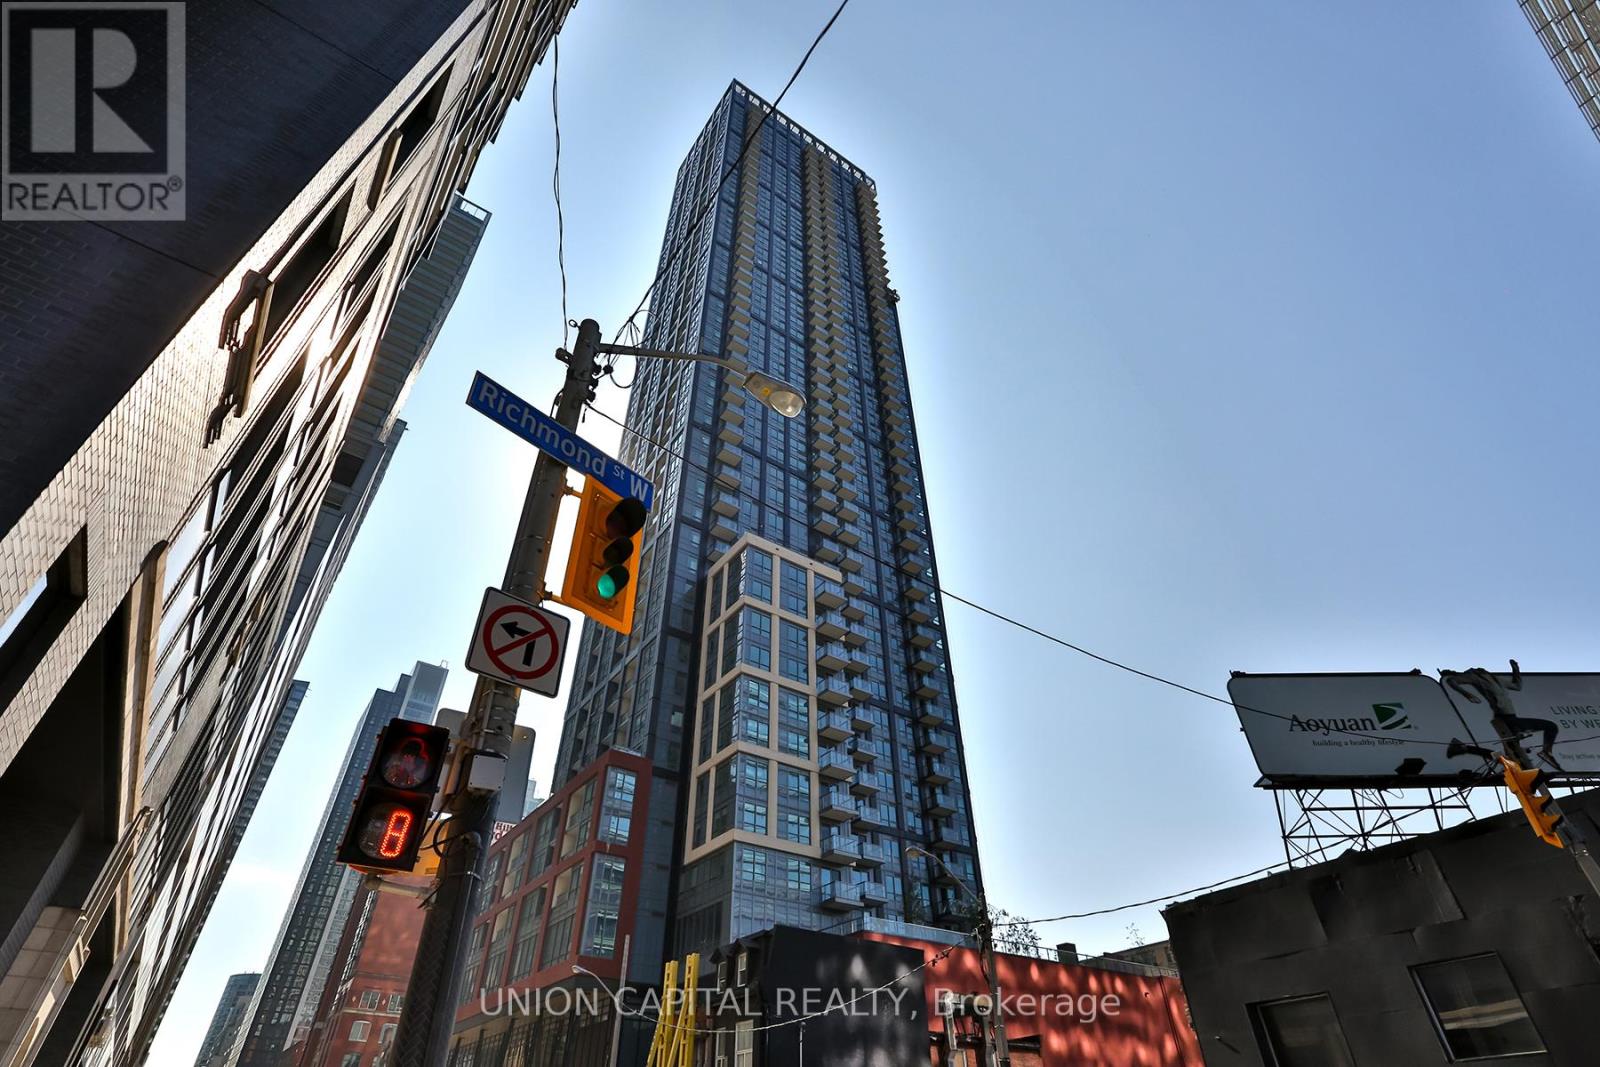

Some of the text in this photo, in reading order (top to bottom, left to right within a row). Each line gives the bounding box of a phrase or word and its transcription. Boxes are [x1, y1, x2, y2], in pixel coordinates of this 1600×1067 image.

[479, 380, 608, 478] Richmond
[630, 473, 650, 503] W
[1288, 714, 1377, 737] Aoyuan
[1550, 705, 1598, 715] LIVING
[380, 811, 411, 858] 8
